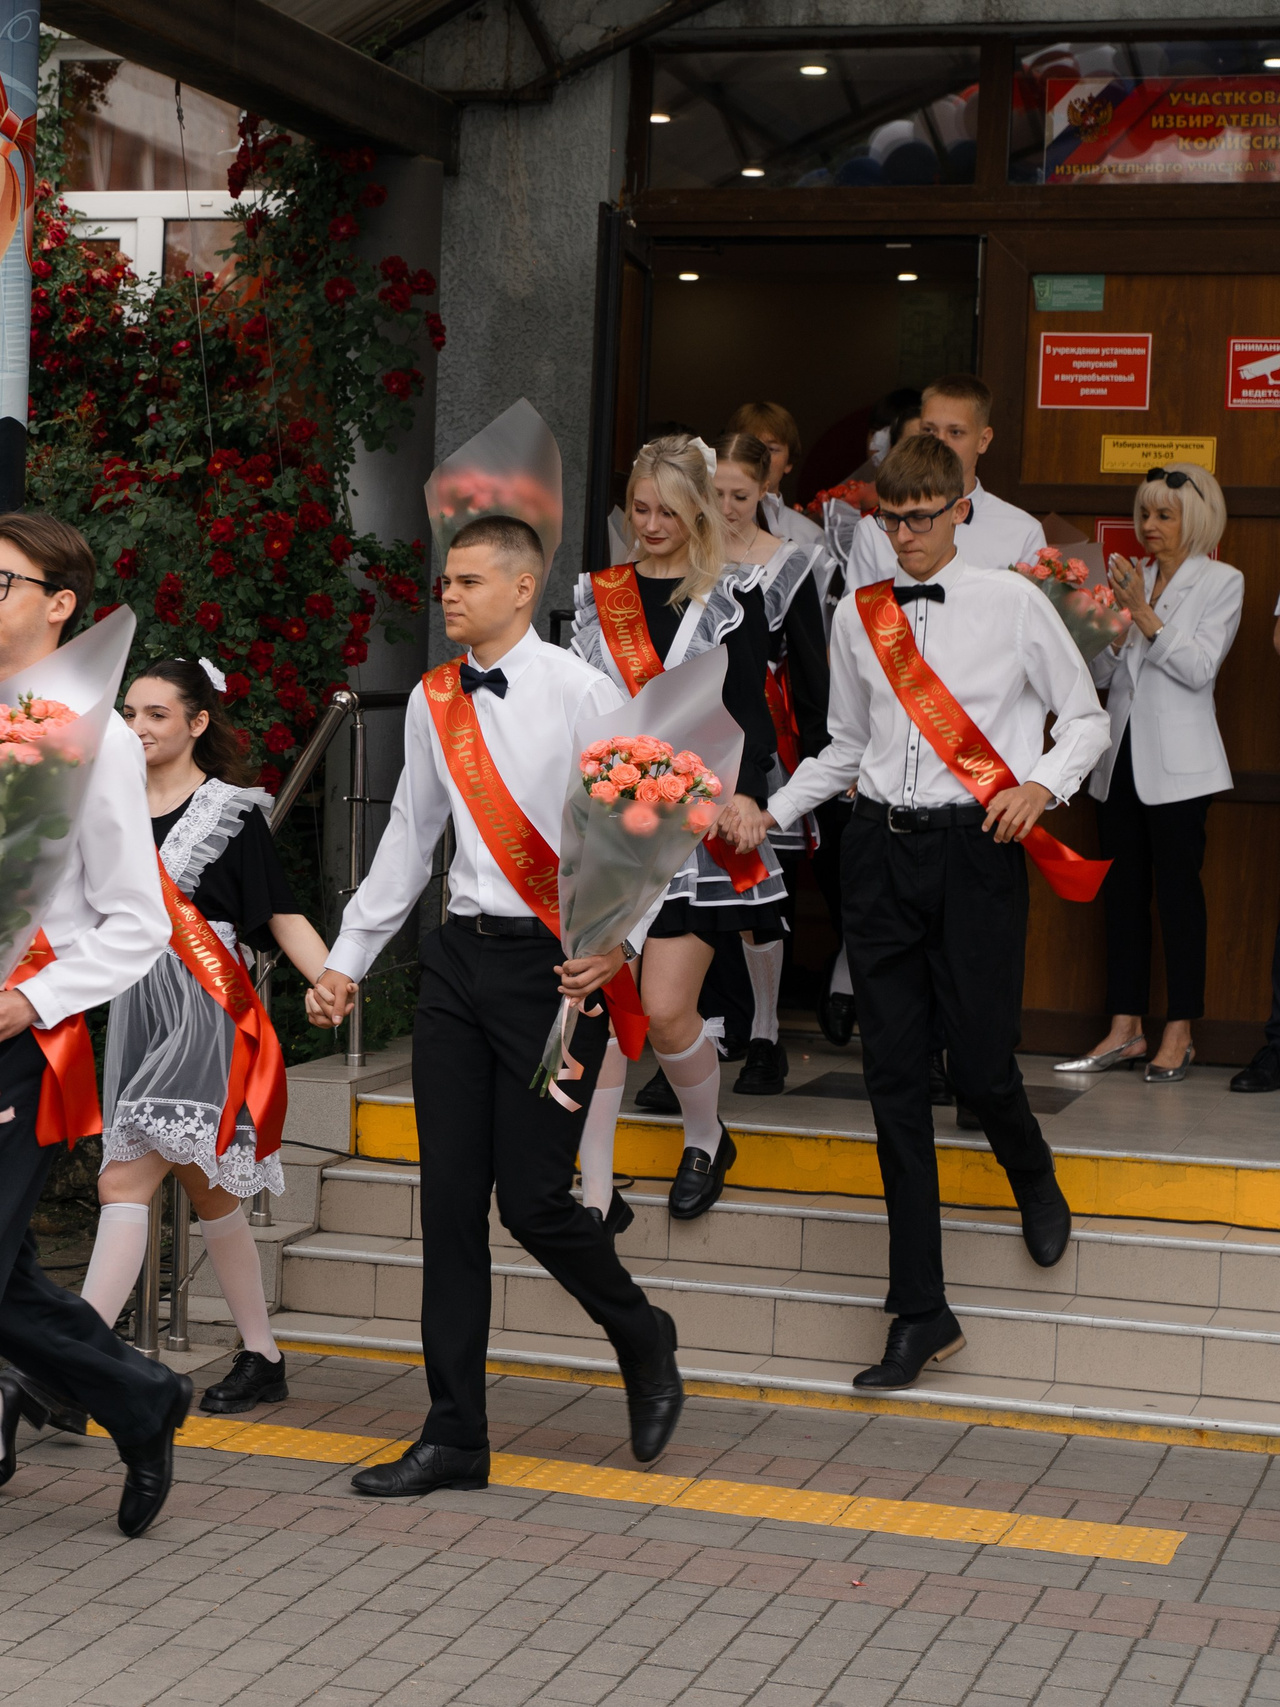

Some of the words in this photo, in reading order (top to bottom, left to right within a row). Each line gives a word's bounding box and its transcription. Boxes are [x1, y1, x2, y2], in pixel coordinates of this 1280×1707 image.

[1151, 112, 1280, 129] ИЗБИРАТЕЛЬ
[1178, 135, 1280, 151] КОМИССИ
[1054, 161, 1183, 176] ИЗБИРАТЕЛЬНОГО
[1187, 160, 1255, 174] УЧАСТКА
[1045, 344, 1051, 354] В
[1052, 346, 1100, 356] учреждении
[1101, 346, 1146, 357] установлен
[1072, 358, 1118, 370] пропускной
[1054, 373, 1060, 381] и
[1080, 387, 1108, 397] режим
[1241, 388, 1280, 398] ВЕДЕТС
[1112, 440, 1174, 450] Избирательный
[1175, 442, 1205, 451] участок
[1141, 451, 1151, 459] №
[870, 595, 964, 748] Выпускник
[955, 743, 1005, 787] 2026
[444, 694, 535, 870] Выпускник
